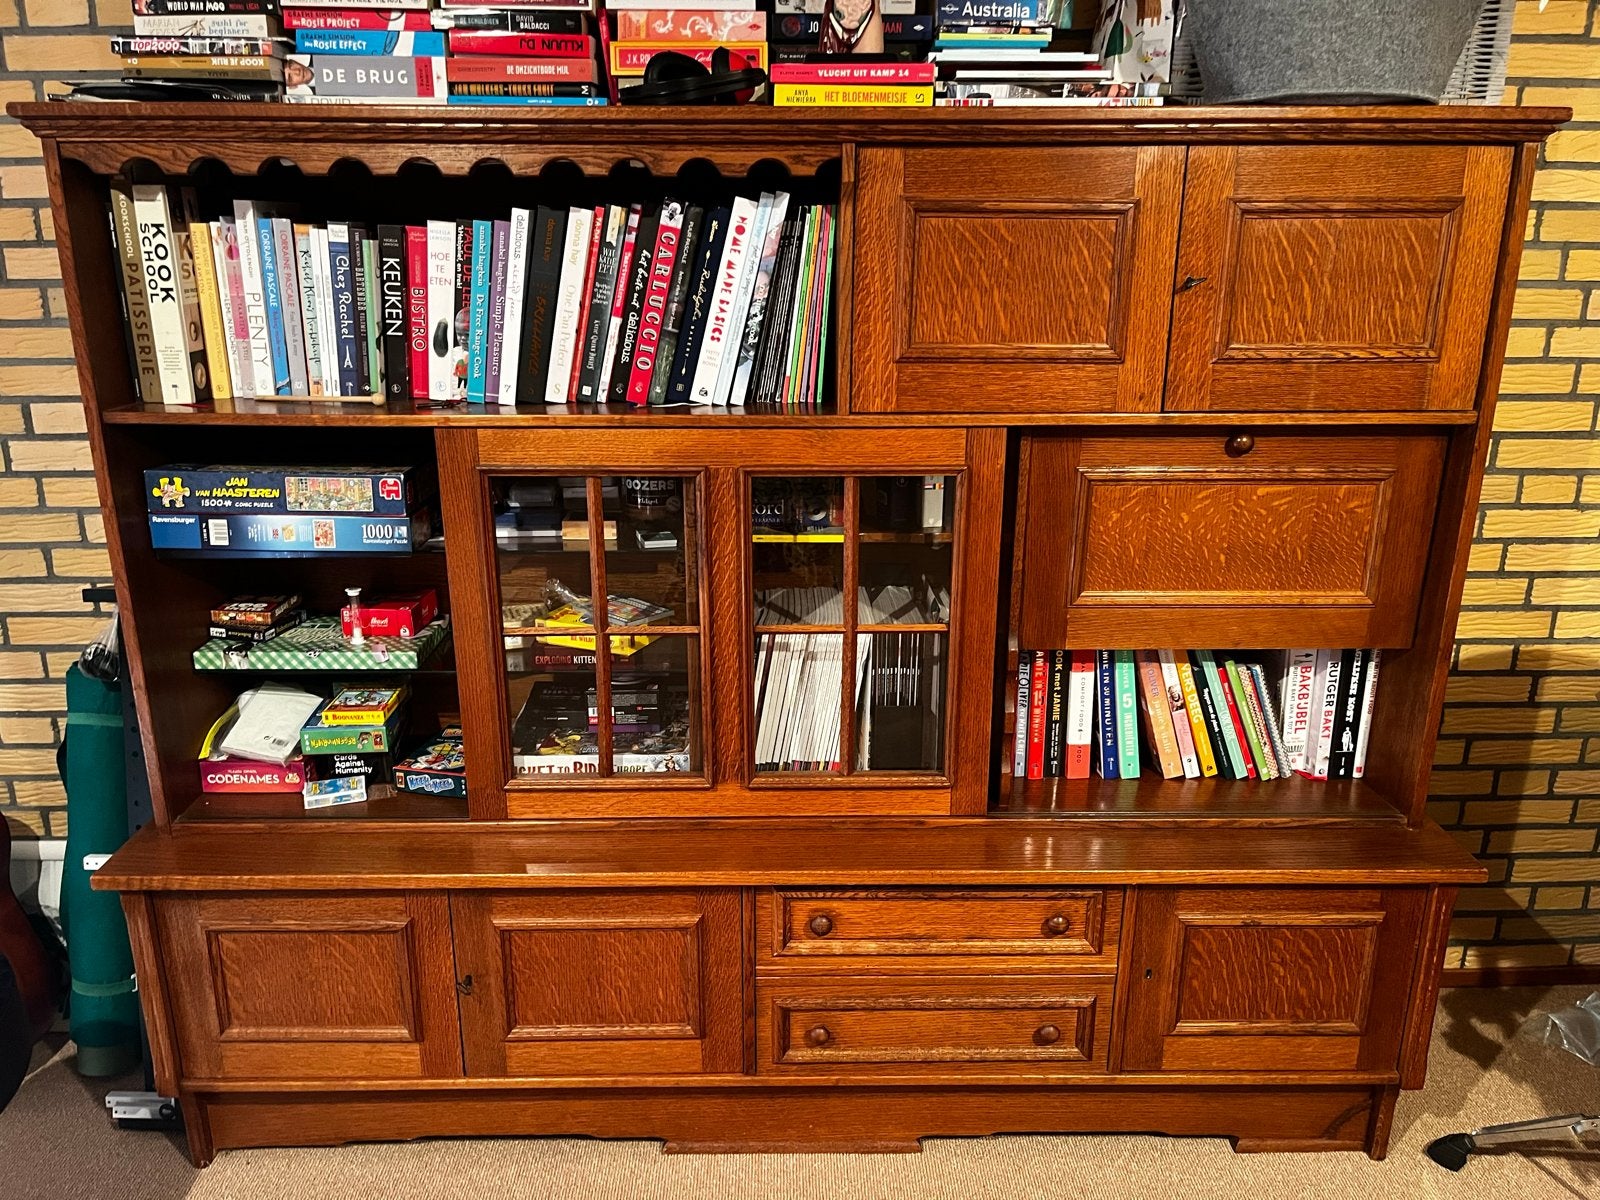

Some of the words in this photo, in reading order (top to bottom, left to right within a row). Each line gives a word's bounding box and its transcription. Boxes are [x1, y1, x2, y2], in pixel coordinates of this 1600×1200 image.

[167, 2, 188, 11] WORLD
[190, 2, 204, 10] WAR
[962, 1, 1030, 18] Australia
[208, 27, 250, 35] beginners
[301, 18, 324, 28] ROSIE
[326, 18, 360, 28] PROJECT
[520, 22, 550, 30] BALDACCI
[314, 40, 337, 49] ROSIE
[339, 41, 366, 50] EFFECT
[240, 58, 264, 66] KOOP
[898, 69, 909, 77] 14
[323, 68, 346, 83] DE
[356, 70, 408, 84] BRUG
[825, 92, 840, 102] HET
[842, 92, 908, 103] BLOEMENMEISJE
[120, 194, 134, 258] KOOKSCHOOL
[513, 214, 524, 259] delicious.
[571, 219, 583, 246] donna
[729, 216, 747, 254] HOME
[261, 229, 273, 269] LORRAINE
[279, 230, 290, 269] LORRAINE
[463, 227, 472, 258] PAUL
[478, 226, 486, 253] annabel
[497, 231, 506, 260] annabel
[681, 238, 690, 263] PASCALE
[140, 223, 160, 303] SCHOOL
[151, 223, 176, 303] KOOK
[430, 252, 450, 261] HOE
[436, 265, 445, 273] TE
[567, 248, 579, 265] hay
[333, 255, 350, 288] Chez
[430, 276, 452, 285] ETEN
[463, 264, 471, 281] DE
[475, 255, 484, 285] langbein
[494, 261, 505, 291] langbein
[720, 259, 737, 295] MADE
[266, 272, 277, 306] PASCALE
[284, 272, 295, 306] PASCALE
[355, 267, 366, 310] BARTENDER
[382, 258, 402, 335] KEUKEN
[476, 294, 484, 307] De
[563, 284, 576, 307] One
[636, 232, 674, 370] CARLUCCIO
[126, 263, 155, 376] PATISSERIE
[338, 292, 353, 338] Rachel
[409, 287, 427, 351] BISTRO
[475, 308, 483, 327] Free
[493, 295, 503, 328] Simple
[560, 309, 573, 329] Pan
[710, 298, 729, 342] BASICS
[245, 292, 270, 367] PLENTY
[472, 329, 482, 354] Range
[620, 311, 638, 364] delicious.
[491, 332, 502, 375] Pleasures
[556, 331, 570, 366] Perfect
[472, 356, 480, 378] Cook
[212, 488, 280, 498] HAASTEREN
[226, 477, 248, 486] JAN
[152, 516, 195, 524] Ravensburger
[361, 524, 392, 538] 1000
[535, 656, 571, 665] EXPLODING
[574, 656, 597, 664] KITTEN
[1034, 651, 1044, 678] AMIE
[1054, 650, 1062, 670] OOK
[1053, 673, 1061, 690] met
[1102, 672, 1110, 683] IN
[1147, 668, 1158, 697] OLIVER
[1324, 662, 1341, 707] RUTGER
[1052, 692, 1060, 720] JAMIE
[1122, 693, 1131, 707] 5
[1180, 663, 1194, 692] VERS
[1187, 693, 1201, 723] DEEG
[1104, 698, 1113, 745] MINUTEN
[1345, 696, 1355, 722] KOST
[1321, 709, 1332, 738] BAKT
[335, 760, 364, 768] Against
[336, 766, 373, 774] Humanity
[574, 761, 599, 774] RID
[207, 774, 280, 784] CODENAMES
